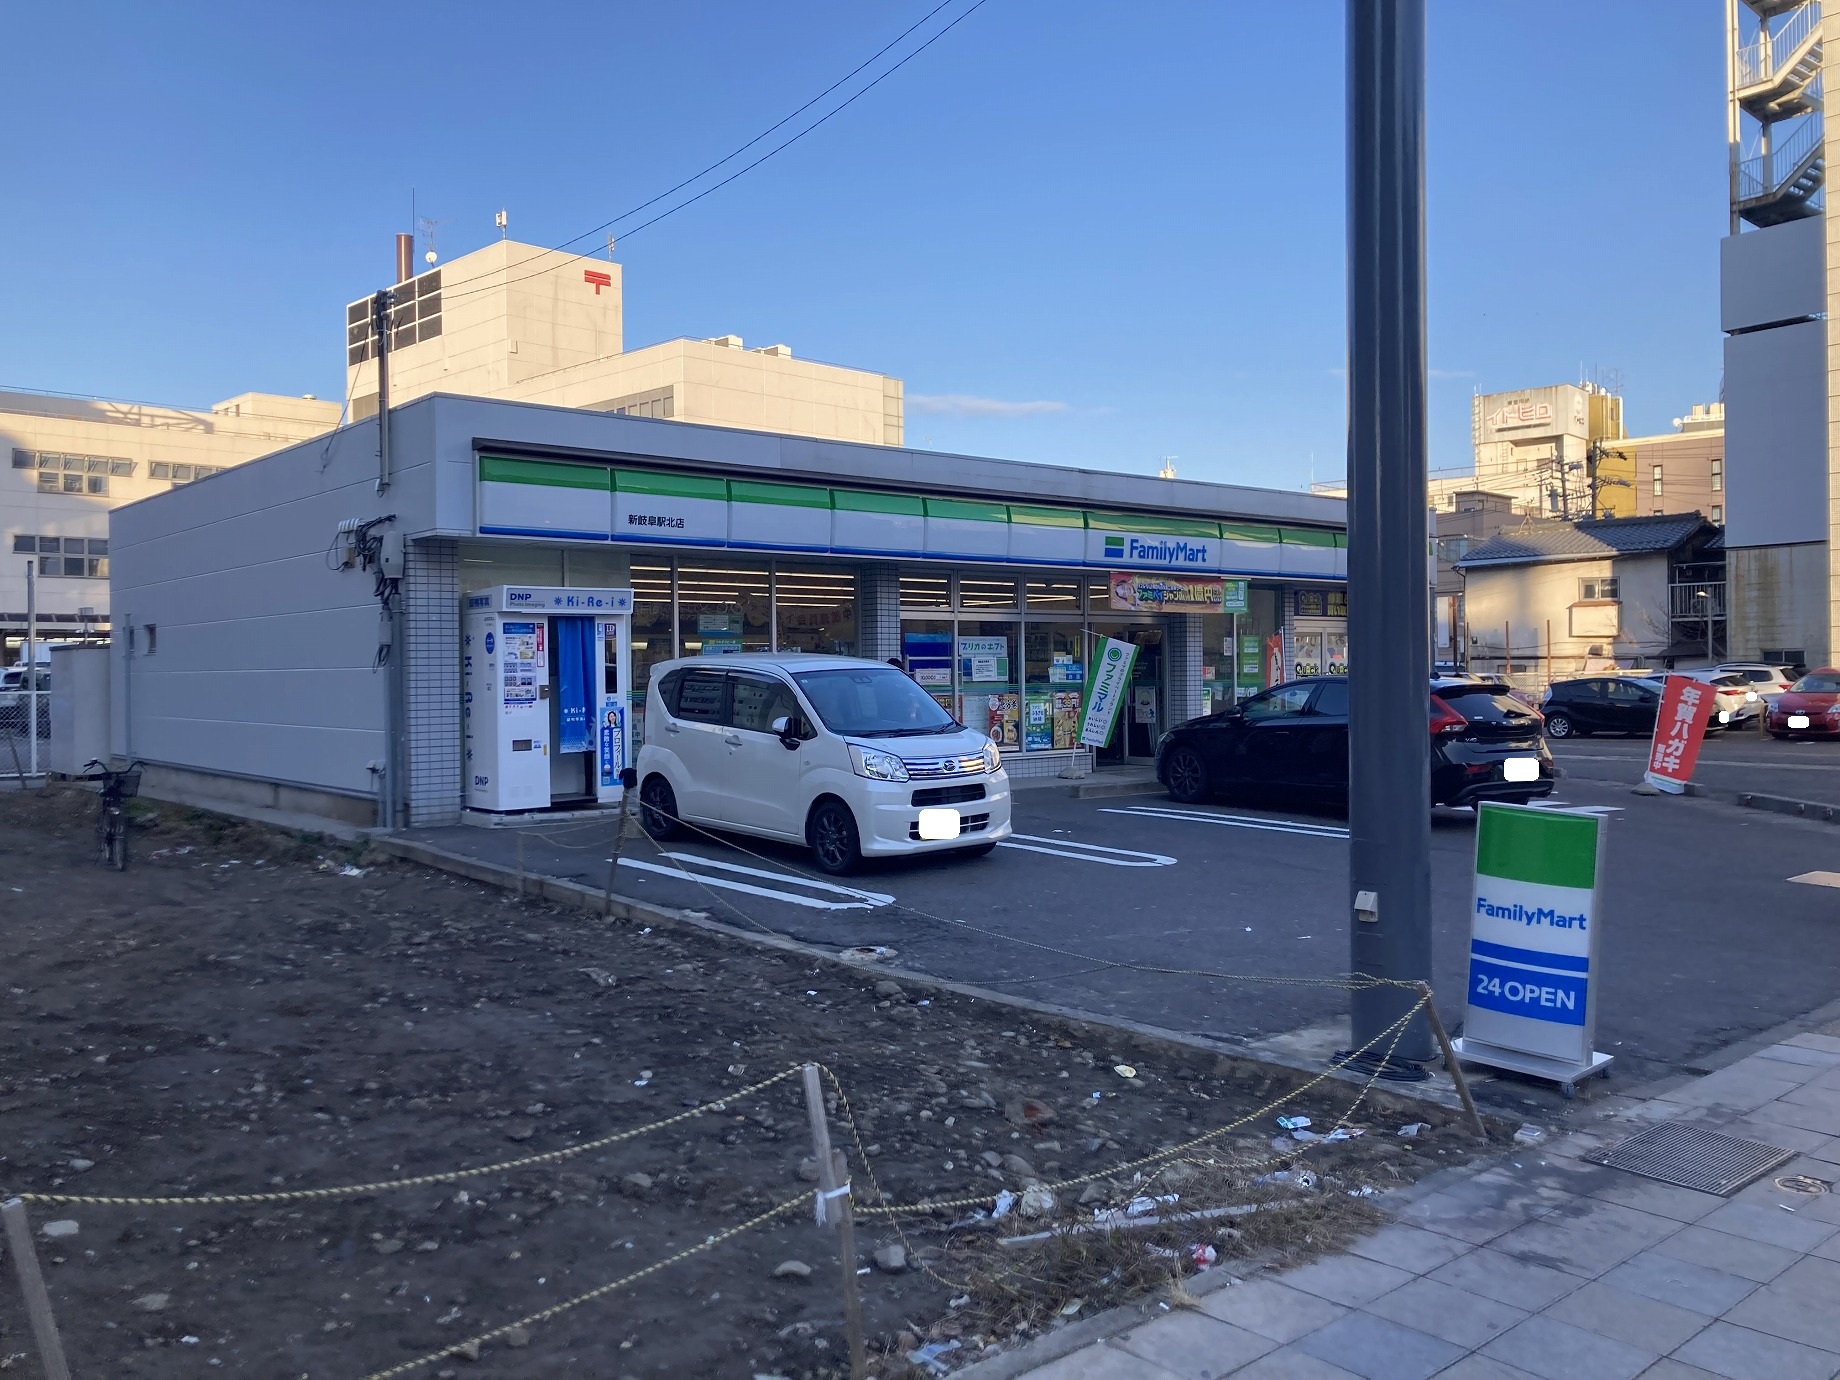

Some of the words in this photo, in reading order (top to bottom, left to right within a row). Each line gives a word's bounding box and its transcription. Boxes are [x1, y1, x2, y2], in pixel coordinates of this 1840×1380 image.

[1486, 401, 1552, 426] イトヒロ
[627, 513, 685, 529] 新岐阜駅北店
[1129, 538, 1208, 564] FamilyMart
[509, 593, 532, 601] DNP
[1295, 661, 1320, 675] Quick
[1329, 661, 1348, 675] Quic
[1092, 662, 1117, 713] ファミマル
[1662, 686, 1703, 773] 年賀ハガキ
[613, 730, 622, 769] プロフィール
[474, 775, 489, 787] DNP
[1475, 896, 1587, 931] FamilyMart
